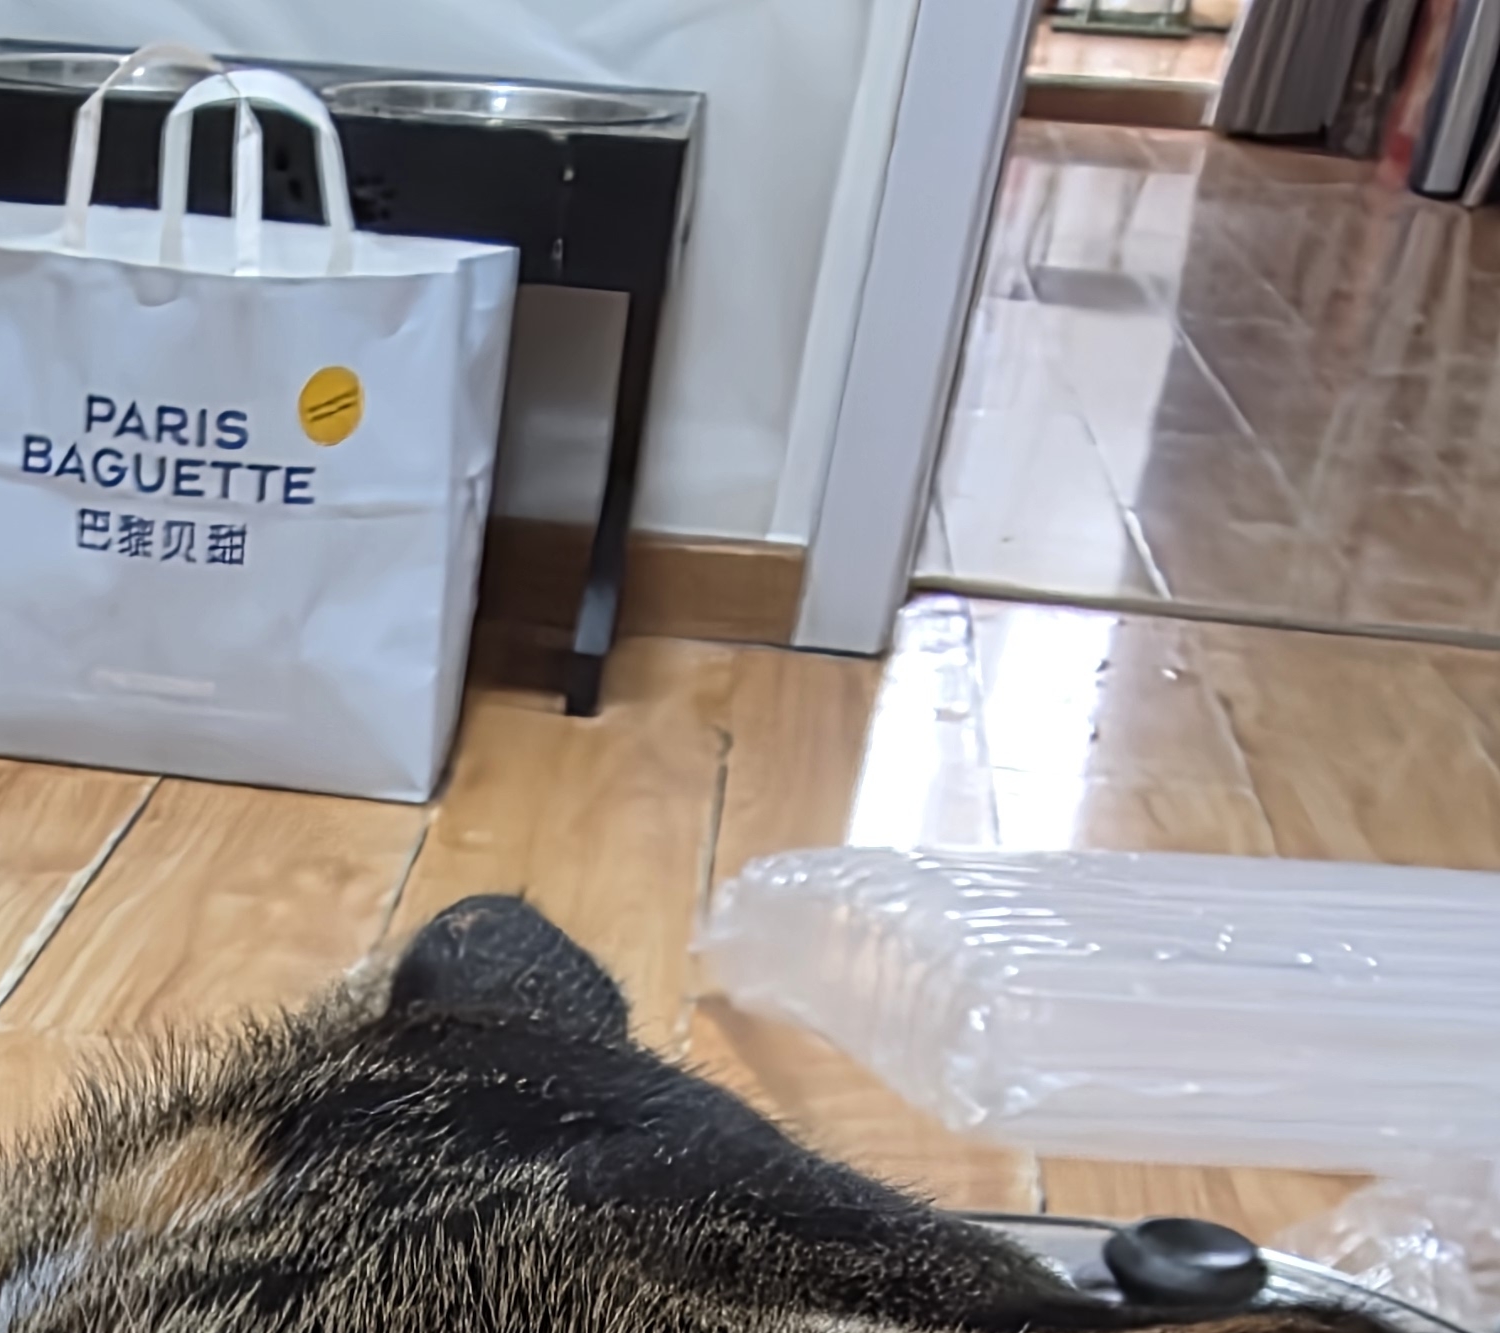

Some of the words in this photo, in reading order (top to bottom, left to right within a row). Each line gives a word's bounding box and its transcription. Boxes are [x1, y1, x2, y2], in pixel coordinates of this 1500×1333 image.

[84, 394, 250, 449] PARIS
[21, 434, 316, 505] BAGUETTE
[76, 508, 248, 566] 巴黎贝甜
